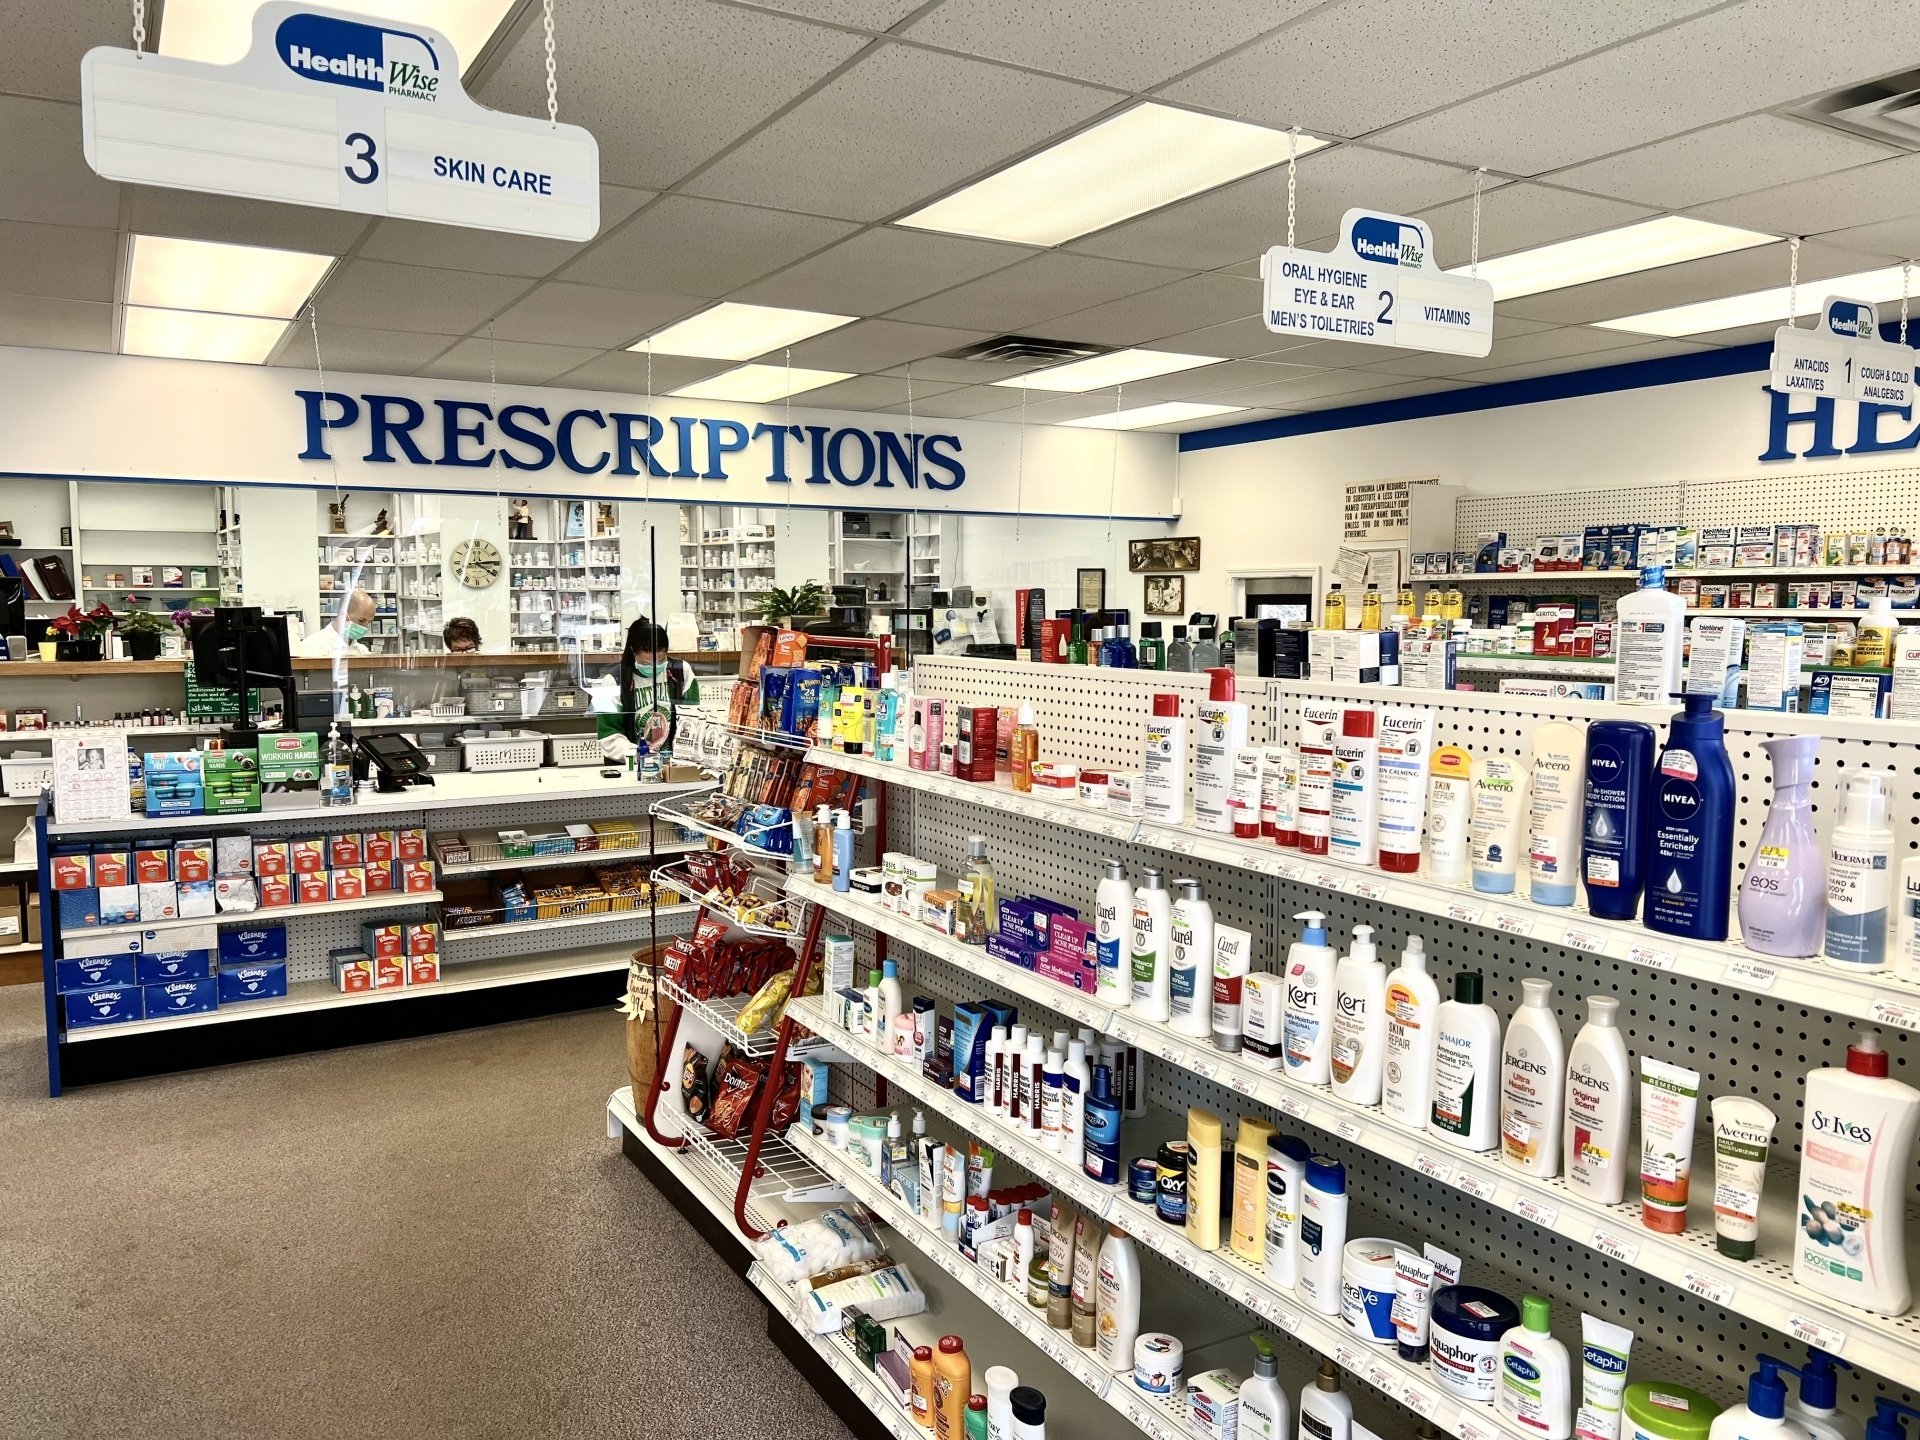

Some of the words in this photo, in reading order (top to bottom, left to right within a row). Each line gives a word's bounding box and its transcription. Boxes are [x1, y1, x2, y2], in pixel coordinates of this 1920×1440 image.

[290, 45, 385, 84] Health
[389, 60, 438, 93] Wise
[388, 87, 437, 102] PHARMACY
[344, 132, 379, 184] 3
[433, 155, 485, 184] SKIN
[492, 165, 552, 195] CARE
[1357, 238, 1398, 259] Health
[1400, 243, 1423, 263] Wise
[1282, 262, 1315, 280] ORAL
[1318, 267, 1367, 289] HYGIENE
[1294, 288, 1317, 305] EYE
[1320, 291, 1329, 306] &
[1332, 294, 1355, 310] EAR
[1376, 290, 1394, 325] 2
[1270, 310, 1307, 328] MEN'S
[1310, 315, 1374, 336] TOILETRIES
[1424, 306, 1471, 326] VITAMINS
[1832, 318, 1857, 331] Health
[1858, 321, 1873, 335] Wise
[1794, 358, 1829, 373] ANTACIDS
[1845, 357, 1852, 383] 1
[1786, 375, 1825, 391] LAXATIVES
[1861, 367, 1885, 381] COUGH
[1885, 369, 1890, 381] &
[1892, 370, 1909, 384] COLD
[1864, 386, 1904, 400] ANALGESICS
[295, 390, 967, 490] PRESCRIPTIONS
[1346, 486, 1356, 494] WEST
[1358, 485, 1375, 493] VIRGINIA
[1376, 484, 1385, 492] LAW
[1387, 482, 1406, 491] REQUIRES
[1345, 495, 1351, 503] TO
[1353, 493, 1376, 503] SUBSTITUTE
[1383, 491, 1393, 500] LESS
[1345, 503, 1359, 511] NAMED
[1361, 501, 1397, 511] THERAPEUTICALLY
[1360, 511, 1374, 519] BRAND
[1377, 510, 1388, 518] NAME
[1345, 521, 1359, 529] UNLESS
[1362, 520, 1371, 528] YOU
[1383, 519, 1394, 527] YOUR
[804, 688, 815, 697] 24
[1303, 707, 1339, 720] Eucerin
[1147, 724, 1171, 735] Eucerin
[1383, 715, 1423, 730] Eucerin
[262, 752, 293, 761] WORKING
[294, 751, 318, 760] HANDS
[1238, 753, 1256, 761] Eucerin
[1335, 746, 1364, 759] Eucerin
[1533, 757, 1571, 772] Aveeno
[1592, 758, 1617, 768] NIVEA
[1434, 781, 1451, 791] SKIN
[1474, 779, 1514, 793] Aveeno
[1593, 788, 1626, 797] IN-SHOWER
[1601, 795, 1626, 803] LOTION
[1664, 793, 1696, 805] NIVEA
[400, 838, 421, 846] Kleenex
[1657, 830, 1700, 845] Essentially
[1659, 849, 1673, 857] 48hr
[1660, 840, 1695, 852] Enriched
[296, 850, 318, 859] Kleenex
[1831, 849, 1871, 865] MEDERMA
[98, 862, 124, 871] Kleenex
[903, 864, 917, 877] basis
[338, 877, 360, 886] Kleenex
[1751, 875, 1779, 891] eos
[1096, 901, 1116, 921] Curél
[238, 931, 268, 941] Kleenex
[378, 935, 398, 943] Kleenex
[1171, 925, 1193, 946] Curél
[1217, 936, 1240, 956] Curél
[79, 958, 112, 968] Kleenex
[380, 966, 401, 974] Kleenex
[238, 969, 268, 980] Kleenex
[1073, 970, 1083, 989] 5
[165, 983, 197, 994] Kleenex
[88, 993, 121, 1004] Kleenex
[1288, 984, 1317, 1009] Keri
[1337, 989, 1366, 1017] Keri
[1294, 1013, 1320, 1026] Moisture
[1388, 1021, 1405, 1037] SKIN
[1243, 1035, 1270, 1053] Neutrogena
[1388, 1034, 1411, 1051] REPAIR
[1444, 1034, 1472, 1049] MAJOR
[1437, 1044, 1470, 1060] Ammonium
[1437, 1051, 1457, 1064] Lactate
[1457, 1059, 1474, 1069] 12%
[1505, 1051, 1547, 1076] JERGENS
[724, 1072, 749, 1091] Doritos
[1512, 1072, 1531, 1086] Ultra
[1569, 1066, 1610, 1092] JERGENS
[1648, 1077, 1682, 1093] REMEDY
[1508, 1079, 1536, 1096] Healing
[1572, 1087, 1601, 1104] Original
[1574, 1098, 1596, 1113] Scent
[1717, 1123, 1768, 1144] Aveeno
[1833, 1116, 1872, 1143] Ives
[1160, 1175, 1184, 1192] OXY
[1804, 1251, 1830, 1269] 100%
[1395, 1259, 1430, 1281] Aquaphor
[1432, 1331, 1477, 1363] Aquaphor
[1583, 1347, 1625, 1371] Cetaphil
[1505, 1357, 1536, 1379] Cetaphil
